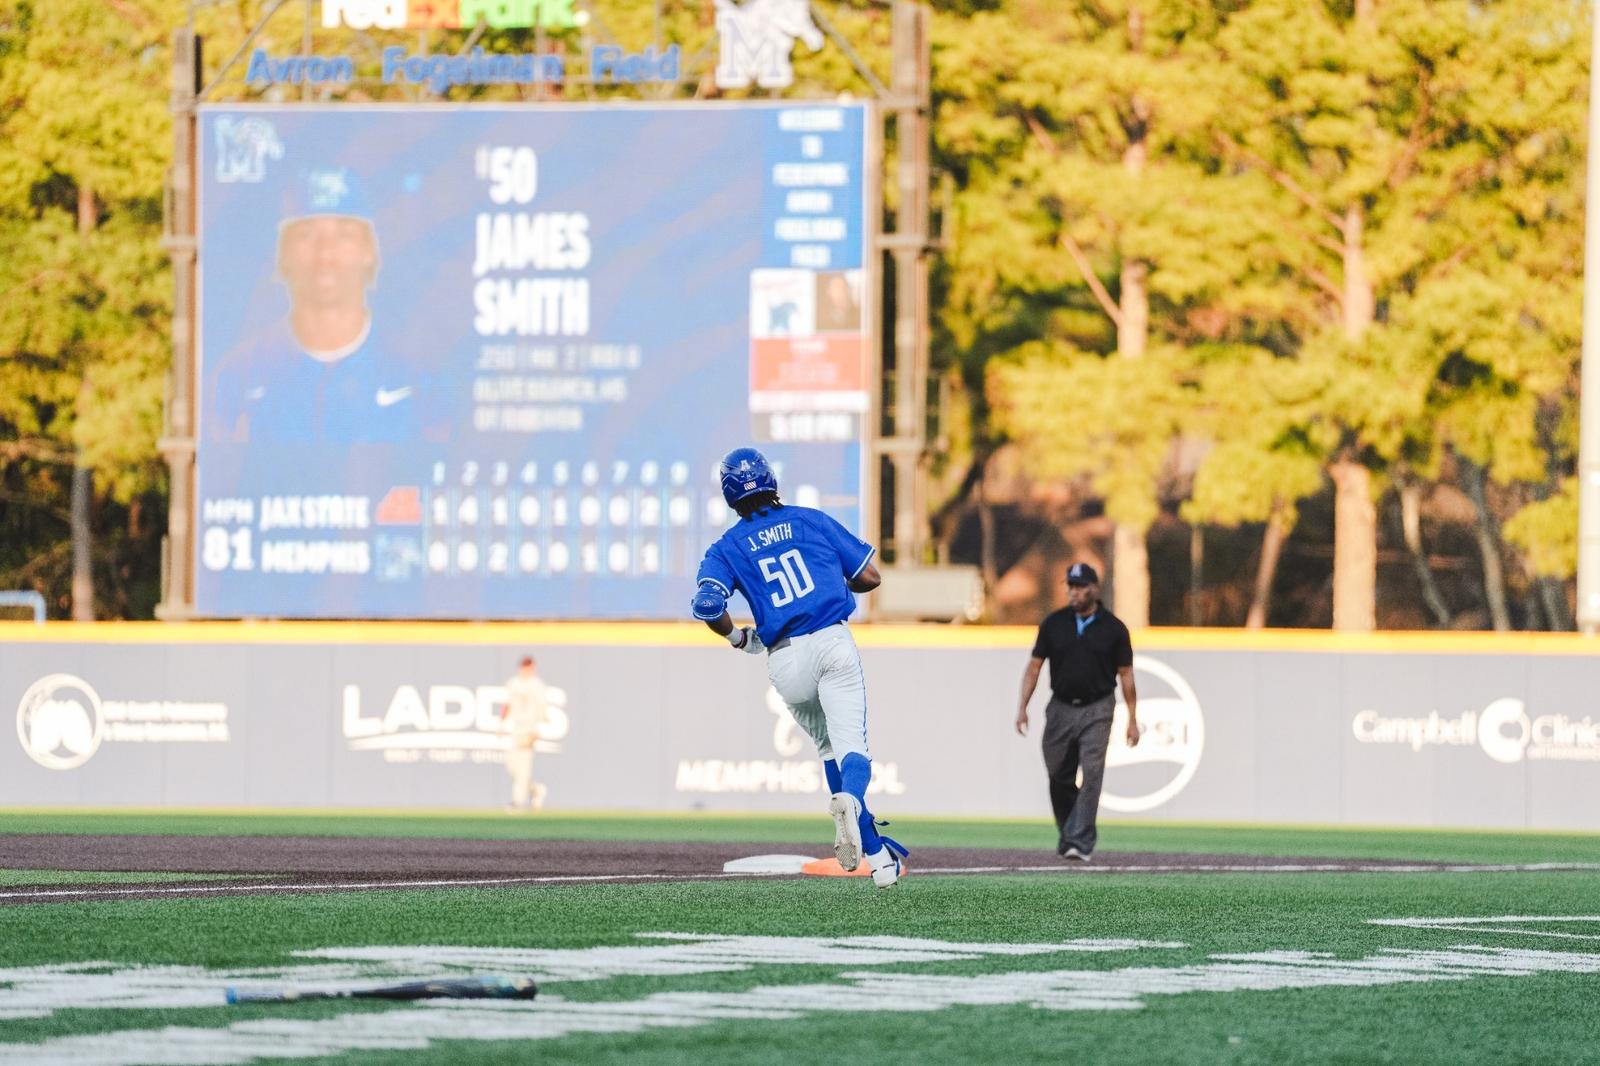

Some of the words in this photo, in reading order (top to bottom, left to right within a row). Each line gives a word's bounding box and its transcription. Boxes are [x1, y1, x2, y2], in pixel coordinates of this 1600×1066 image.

[245, 47, 354, 84] Avron
[382, 45, 565, 95] Fogelman
[591, 44, 681, 82] Field
[473, 211, 591, 277] JAMES
[473, 277, 590, 337] SMITH
[203, 499, 254, 522] MPH
[458, 496, 478, 525] 4
[520, 497, 540, 526] 0
[202, 527, 253, 571] 81
[261, 541, 370, 574] MEMPHIS
[428, 541, 449, 571] 0
[457, 541, 478, 571] 0
[748, 536, 761, 552] J.
[760, 523, 793, 547] SMITH
[757, 548, 816, 608] 50
[342, 683, 570, 740] LADDS
[1352, 709, 1477, 753] Campbell
[675, 759, 820, 793] MEMPHIS
